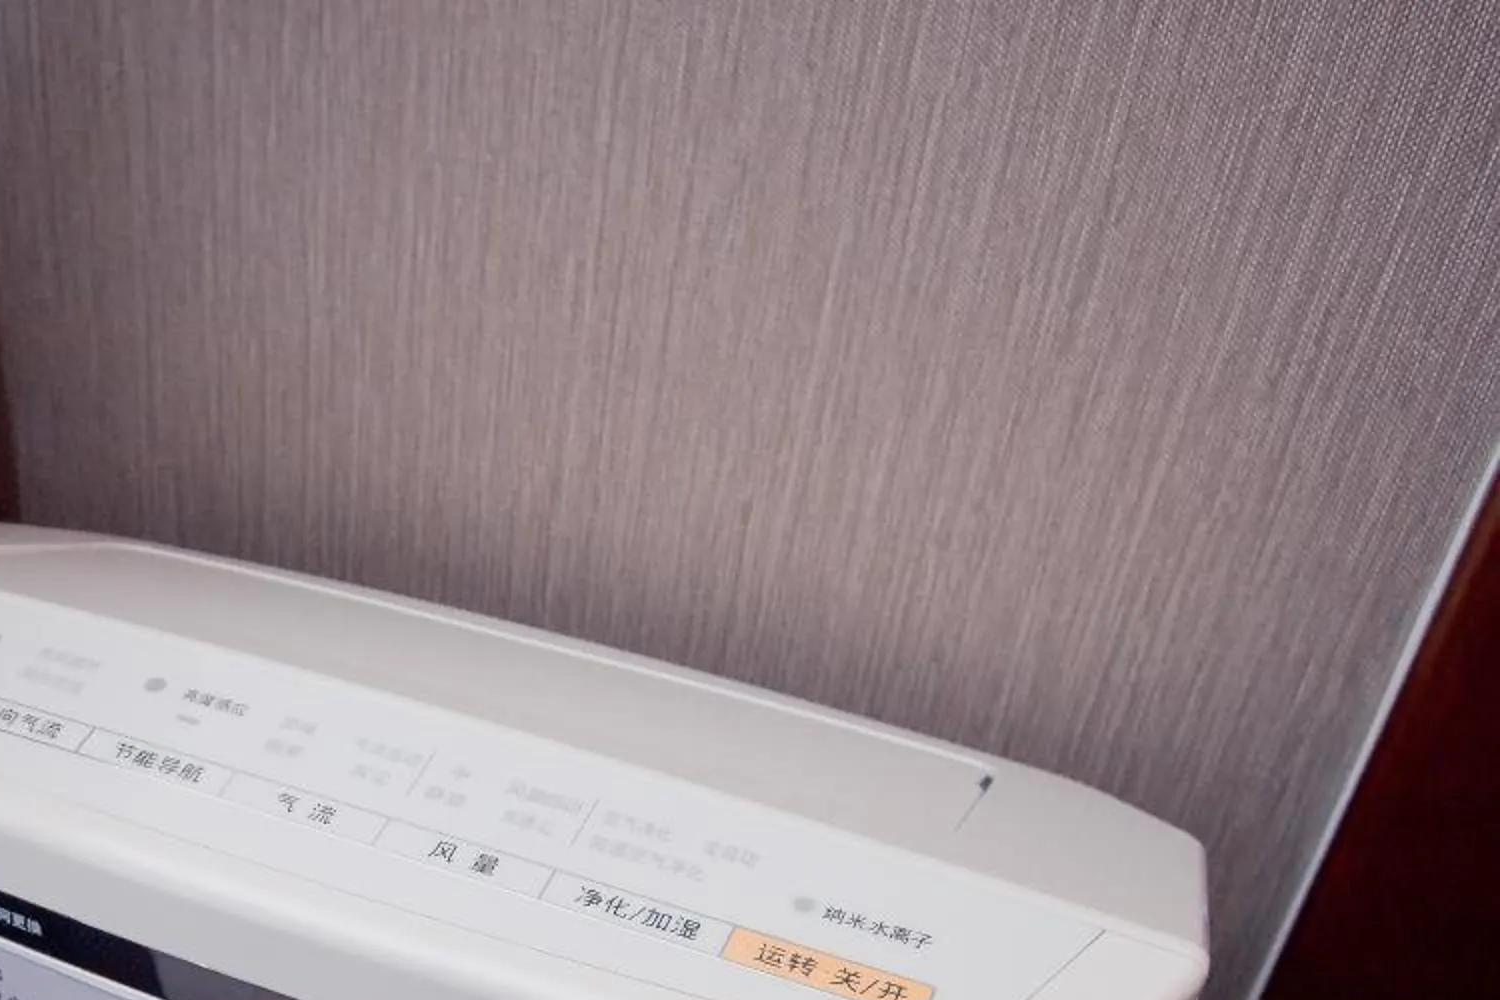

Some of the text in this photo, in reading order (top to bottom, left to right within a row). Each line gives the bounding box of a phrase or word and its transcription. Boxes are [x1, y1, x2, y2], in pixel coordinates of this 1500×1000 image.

[115, 740, 204, 784] 节能导航
[277, 792, 338, 826] 气流
[427, 840, 501, 877] 风量
[573, 885, 702, 943] 净化/加湿
[821, 903, 934, 950] 纳米水离子
